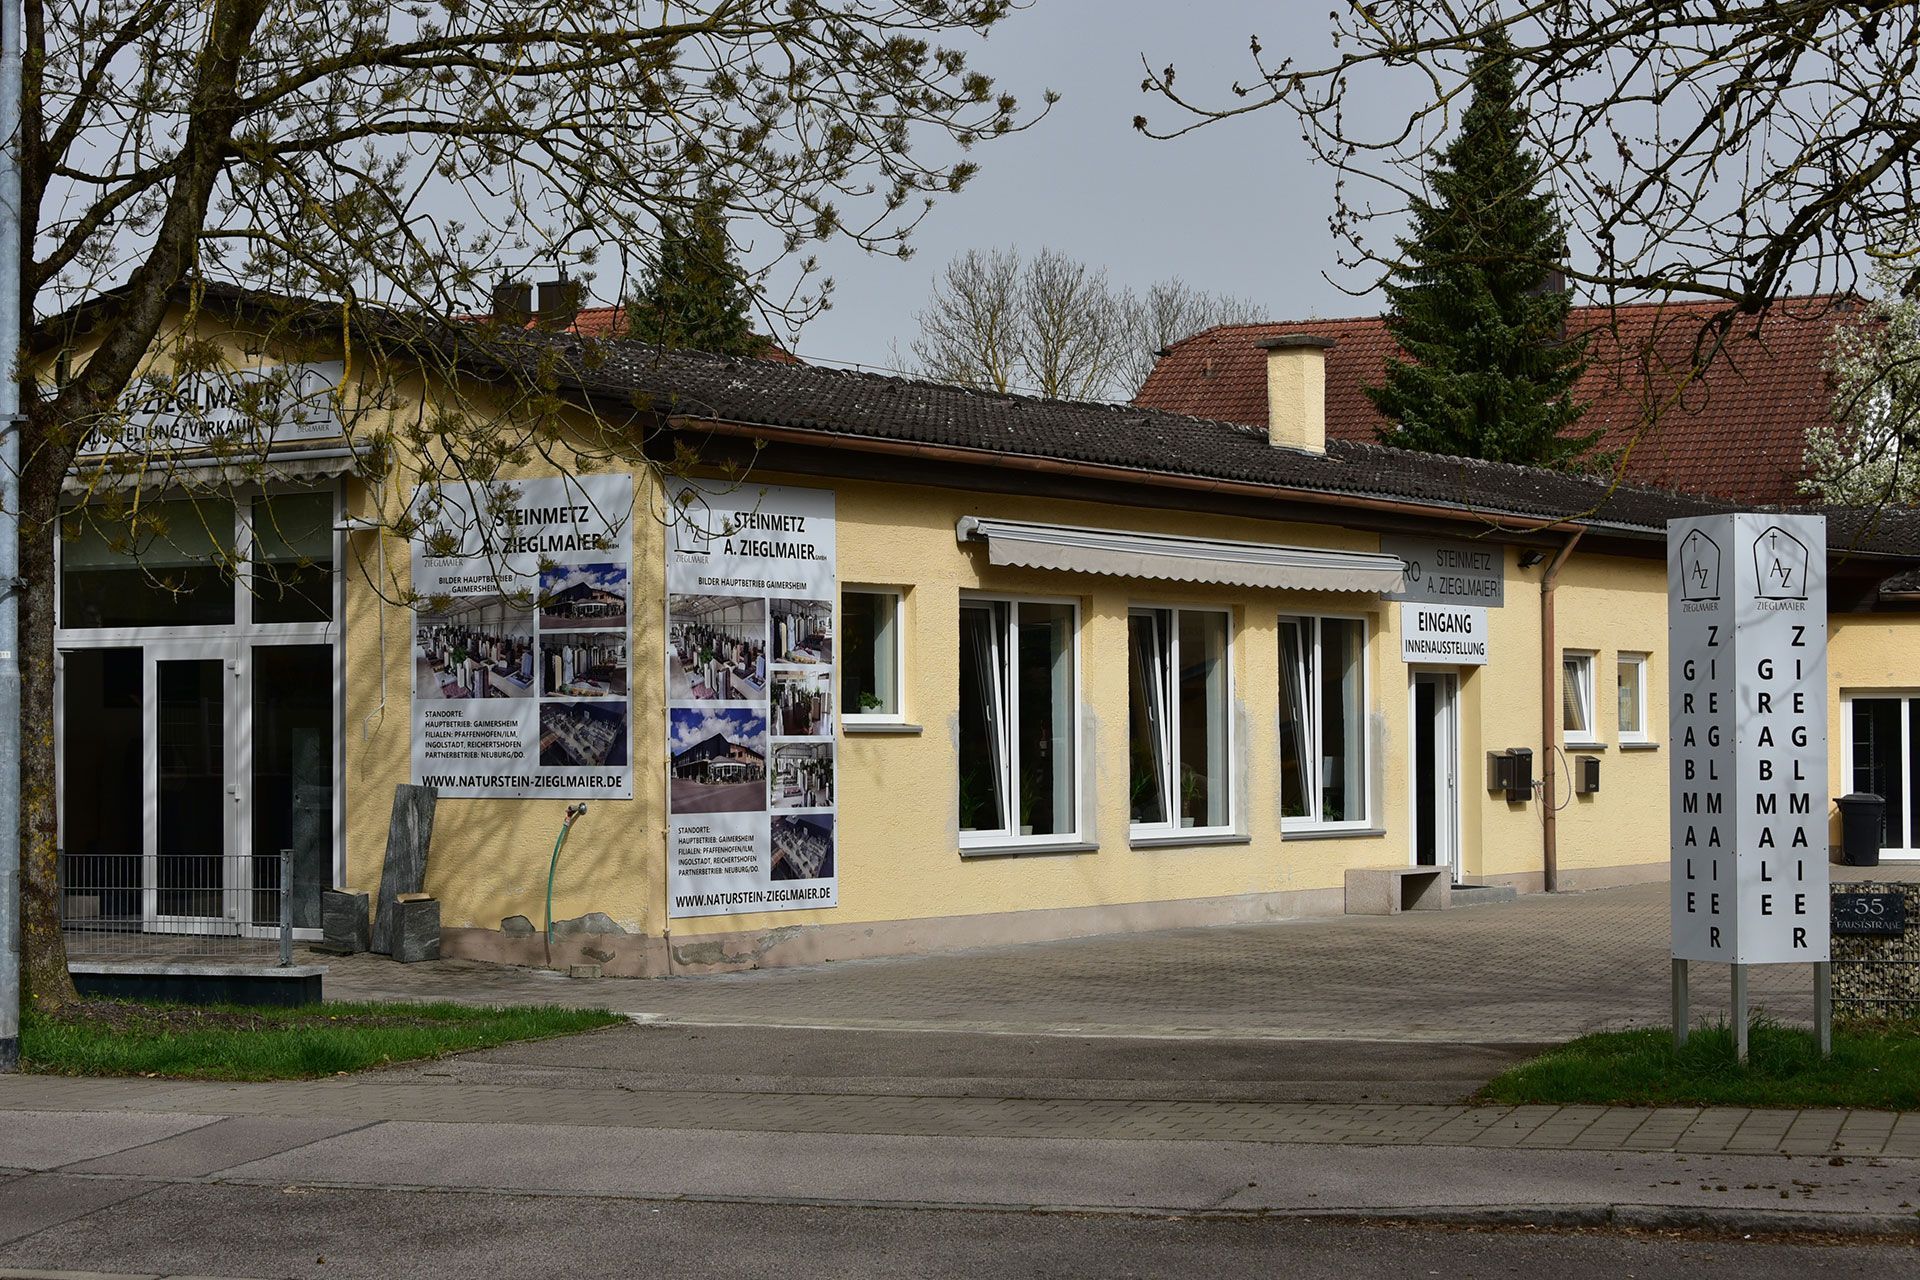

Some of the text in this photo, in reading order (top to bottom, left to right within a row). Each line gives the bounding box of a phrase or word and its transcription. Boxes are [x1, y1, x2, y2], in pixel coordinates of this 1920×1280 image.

[142, 383, 279, 414] ZIEGLMAR
[495, 506, 589, 526] STEINMETZ
[734, 512, 805, 533] STEINMETZ
[502, 534, 602, 554] ZIEGLMAIER
[724, 539, 737, 555] A.
[740, 539, 815, 560] ZIEGLMAIER
[424, 559, 464, 568] ZIEGLMAIER
[676, 555, 709, 564] ZIEGLMAIER
[1437, 549, 1491, 570] STEINMETZ
[439, 576, 462, 584] BILDER
[698, 577, 807, 590] BILDER HAUPTBETRIEB GAIMERSHEIM
[1427, 576, 1437, 593] A.
[1439, 577, 1497, 597] ZIEGLMAIER
[452, 585, 500, 593] GAIMERSHEIM
[1682, 603, 1718, 612] ZIEGLMAIER
[1757, 601, 1806, 611] ZIEGLMAIER
[1418, 611, 1472, 634] EINGANG
[1405, 639, 1485, 656] INNENAUSSTELLUNG
[454, 731, 518, 739] PFAFFENHOFEN/ILM,
[425, 741, 466, 749] INGOLSTADT,
[480, 751, 525, 759] NEUBURG/DO.
[422, 775, 622, 788] WWW.NATURSTEIN-ZIEGLMAIER.DE
[1683, 659, 1698, 913] GRABMALE
[1707, 625, 1722, 948] ZIEGLMAIER
[1756, 658, 1777, 916] GRABMALE
[1789, 625, 1810, 949] ZIEGLMAIER
[678, 826, 711, 834] STANDORTE:
[678, 835, 755, 845] HAUPTBETRIEB: GAIMERSHEIM
[678, 845, 754, 855] FILIALEN: PFAFFENHOFEN/ILM,
[678, 856, 757, 866] INGOLSTADT, REICHERTSHOFEN
[678, 866, 759, 876] PARTNERBETRIEB: NEUBURG/DO.
[676, 887, 831, 908] WWW.NATURSTEIN-ZIEGLMAIER.DE
[1854, 898, 1885, 915] 55
